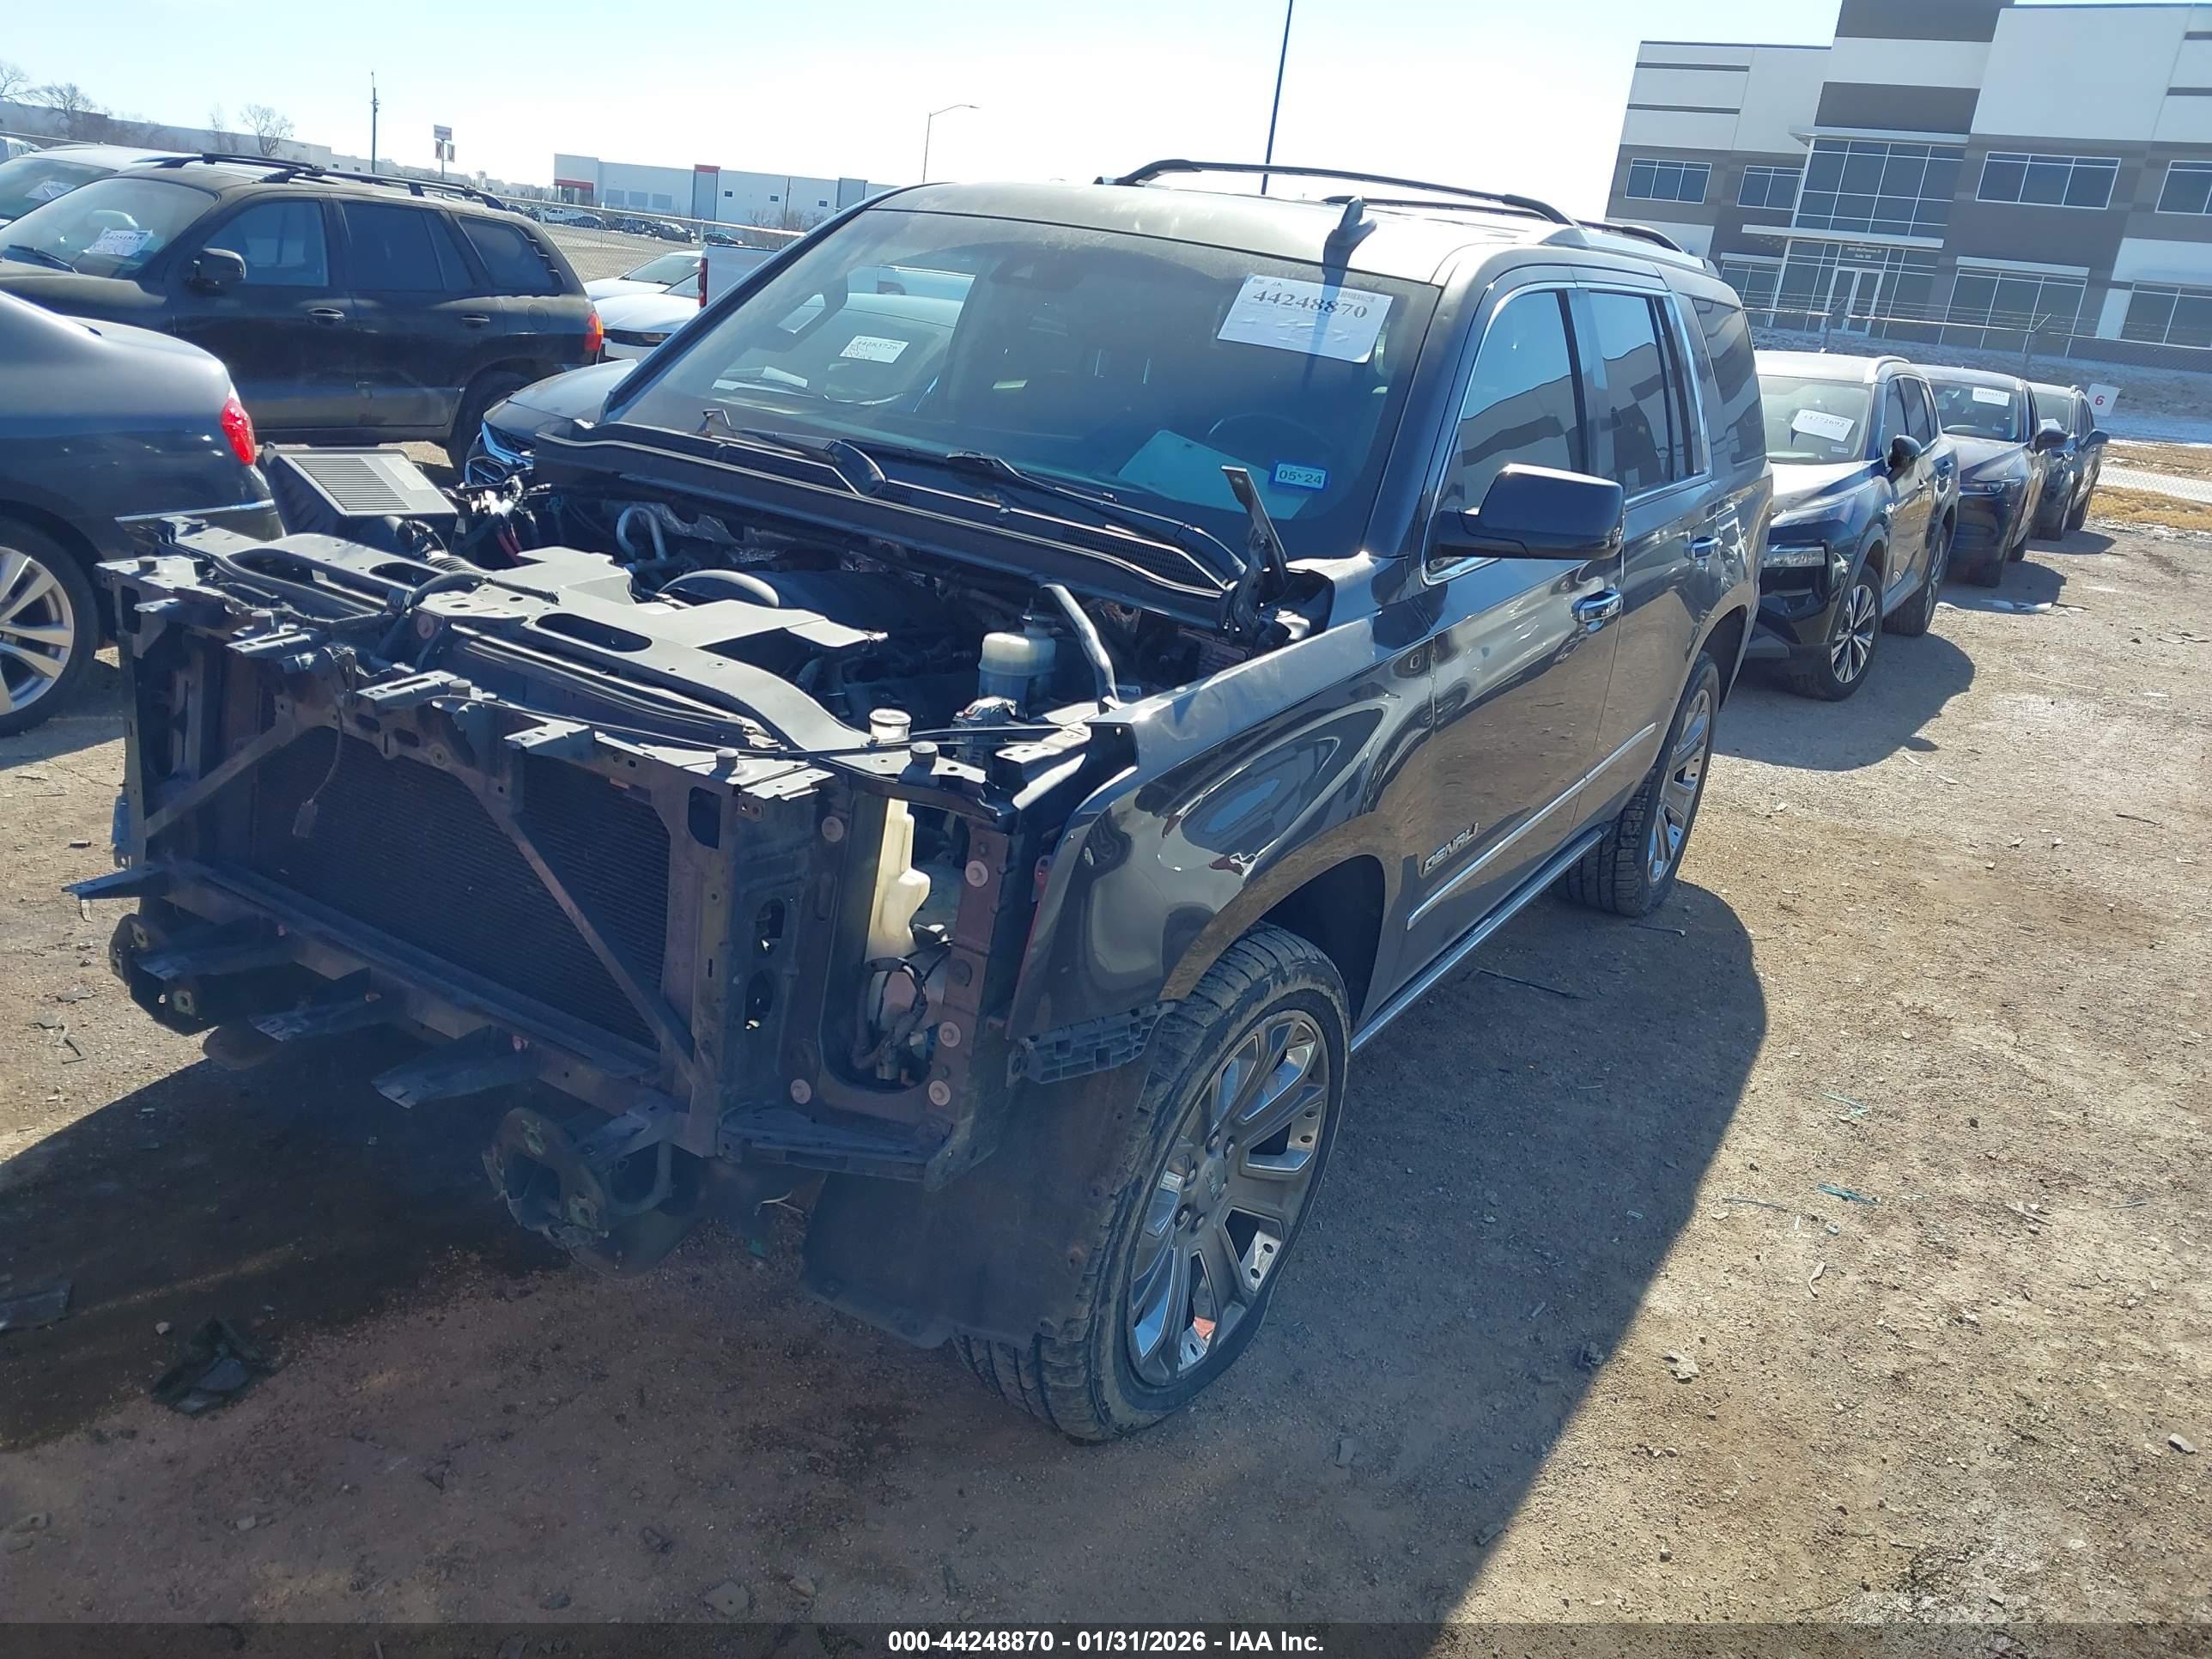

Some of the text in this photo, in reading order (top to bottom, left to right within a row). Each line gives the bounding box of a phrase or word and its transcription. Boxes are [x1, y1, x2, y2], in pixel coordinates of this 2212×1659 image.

[1253, 290, 1368, 319] 44248870
[2095, 395, 2105, 405] 6
[1422, 822, 1479, 875] DENALI
